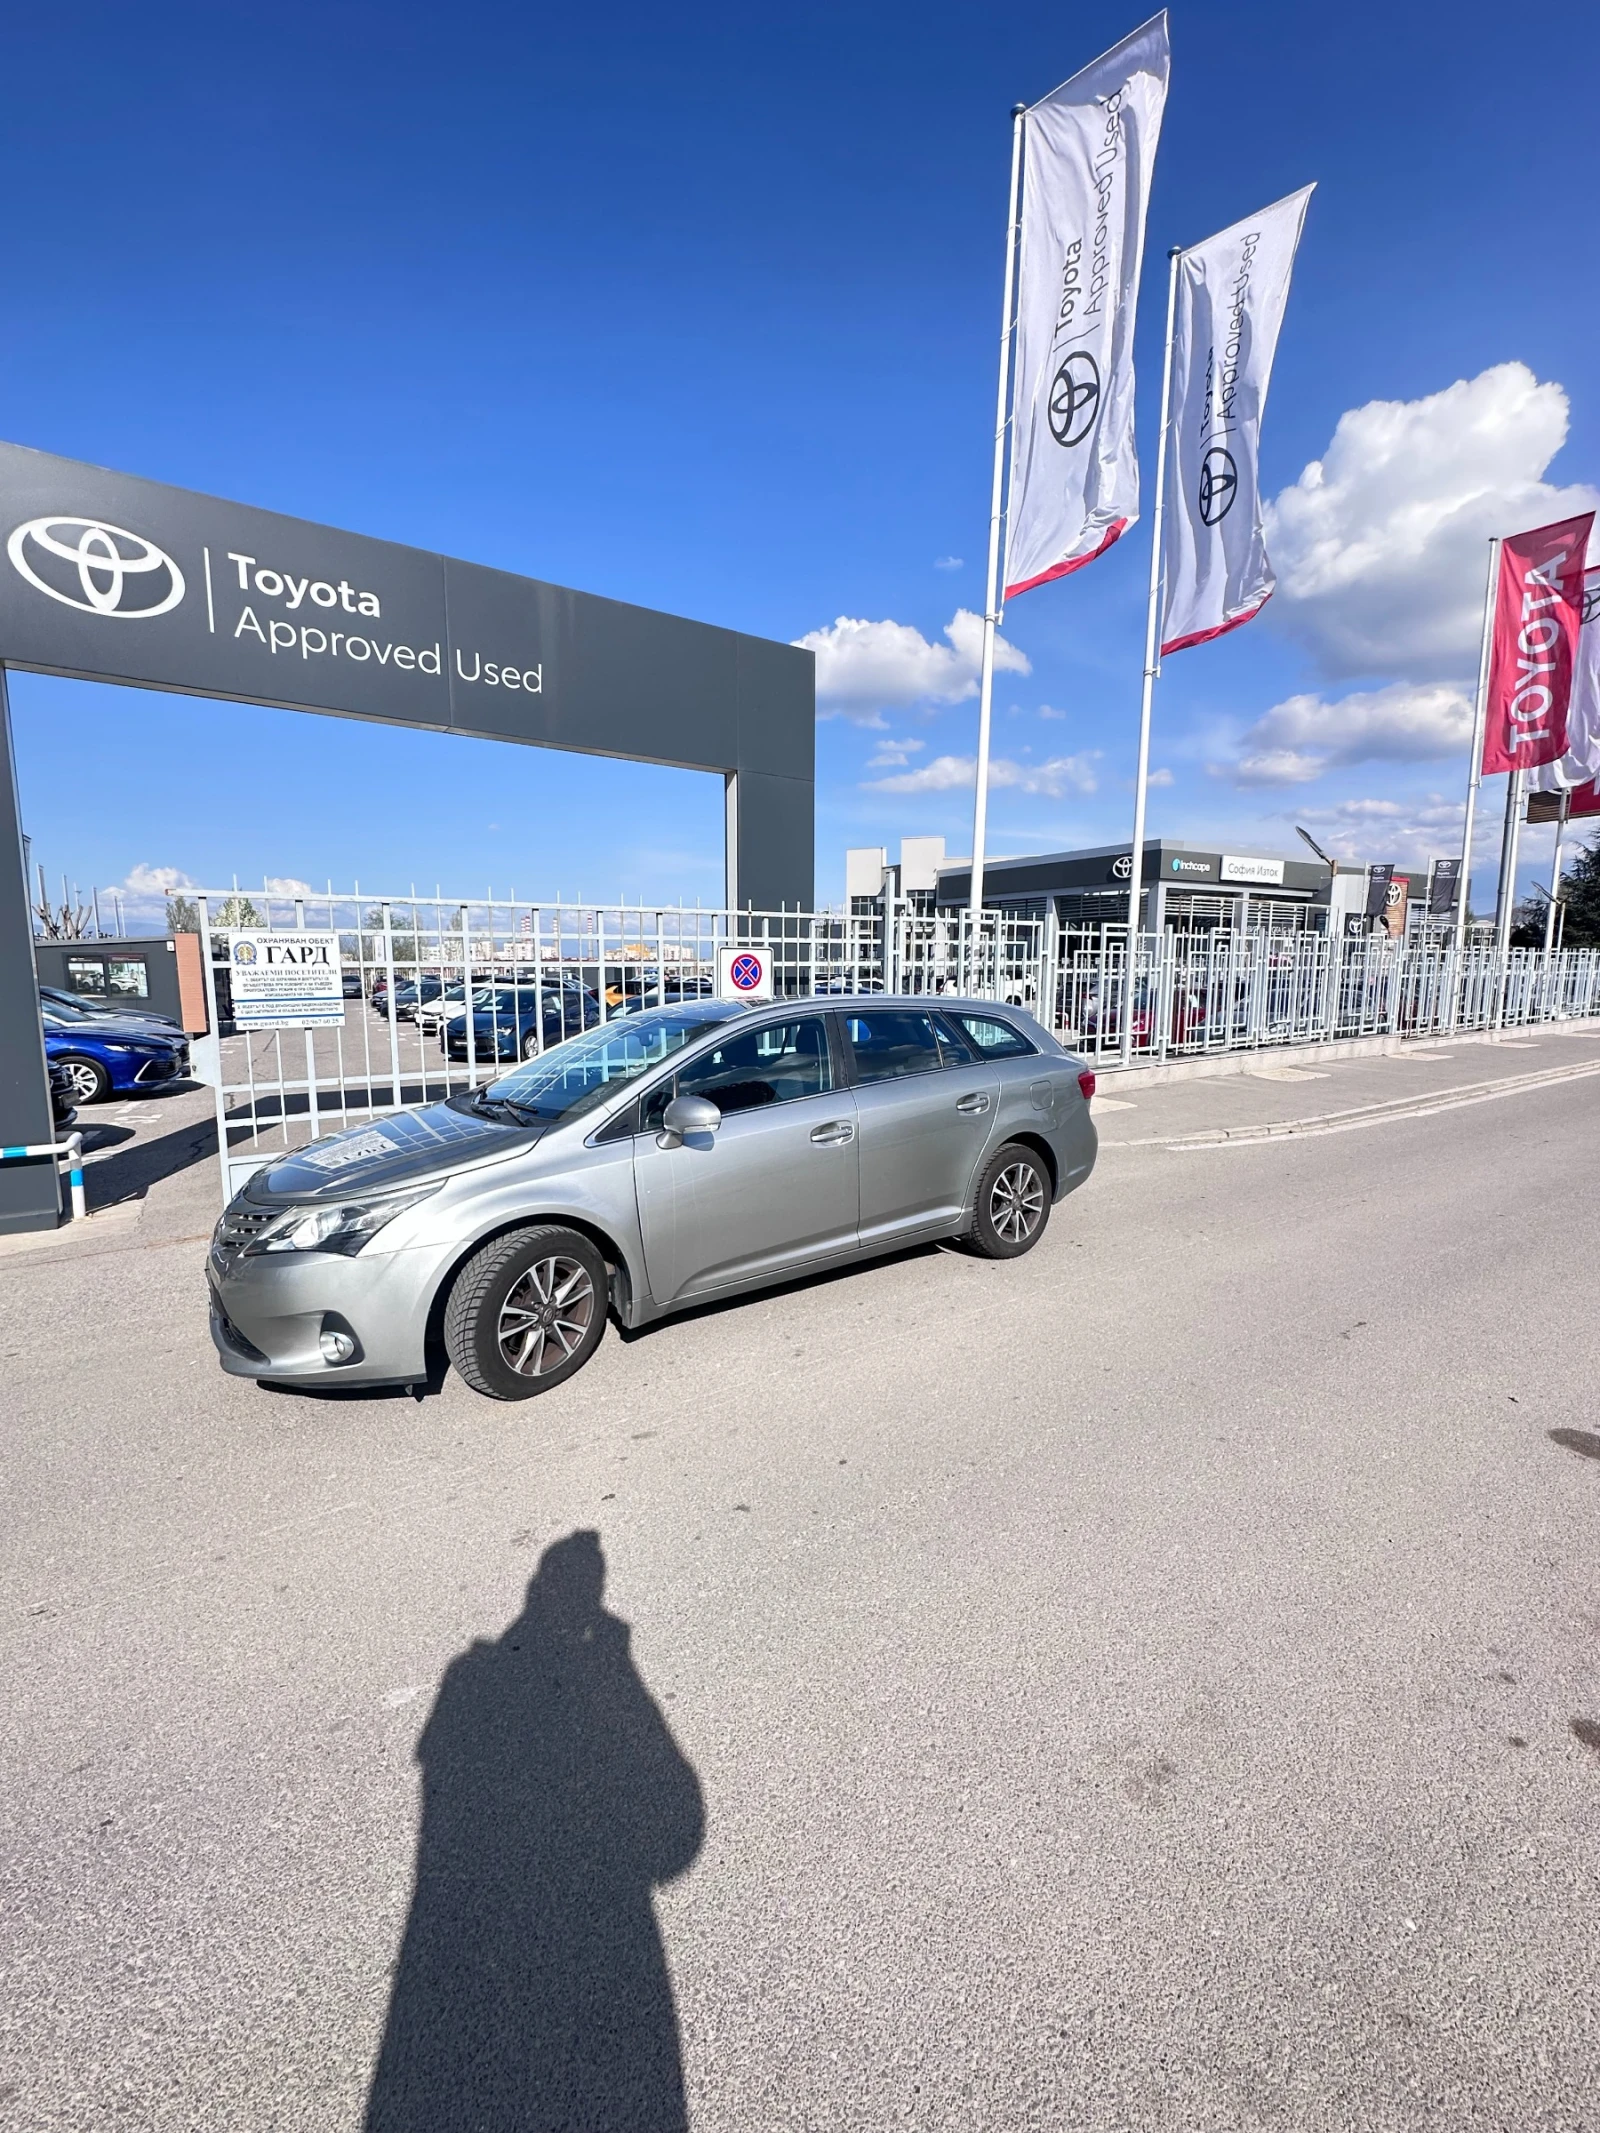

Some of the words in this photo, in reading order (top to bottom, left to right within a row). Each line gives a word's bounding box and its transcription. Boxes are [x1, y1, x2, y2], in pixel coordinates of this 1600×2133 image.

[1096, 88, 1123, 169] Used
[1083, 172, 1114, 316] Approved
[1054, 238, 1083, 339] Toyota
[1217, 300, 1245, 419] Approved
[1233, 231, 1261, 296] Used
[227, 552, 381, 618] Toyota
[233, 606, 442, 675] Approved
[456, 648, 543, 693] Used
[1509, 551, 1567, 754] TOYOTA
[1228, 863, 1256, 876] София
[1256, 865, 1279, 877] Изток
[265, 946, 331, 967] ГАРД
